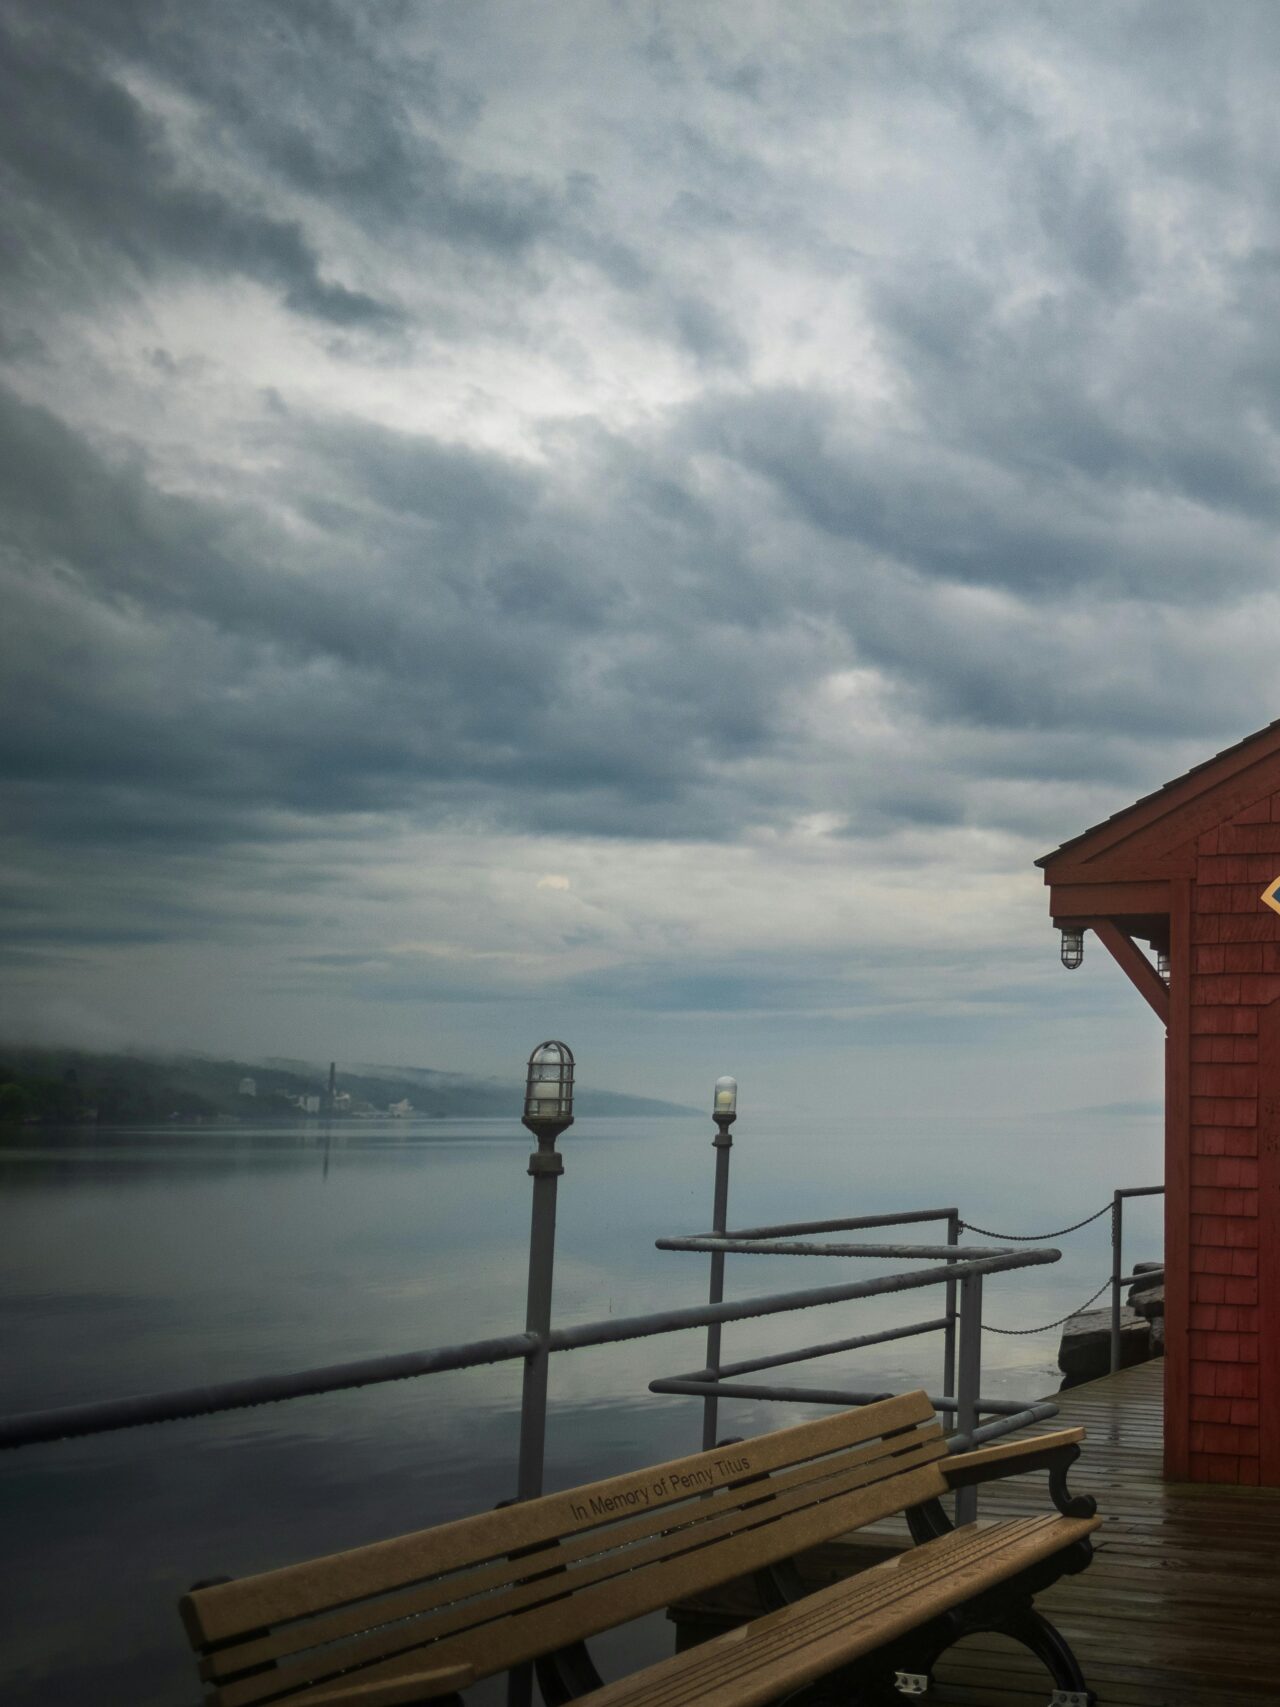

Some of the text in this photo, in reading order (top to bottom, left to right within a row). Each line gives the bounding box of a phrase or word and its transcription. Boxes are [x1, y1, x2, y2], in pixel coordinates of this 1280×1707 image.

[570, 1457, 750, 1521] In Memory of Penny Titus
